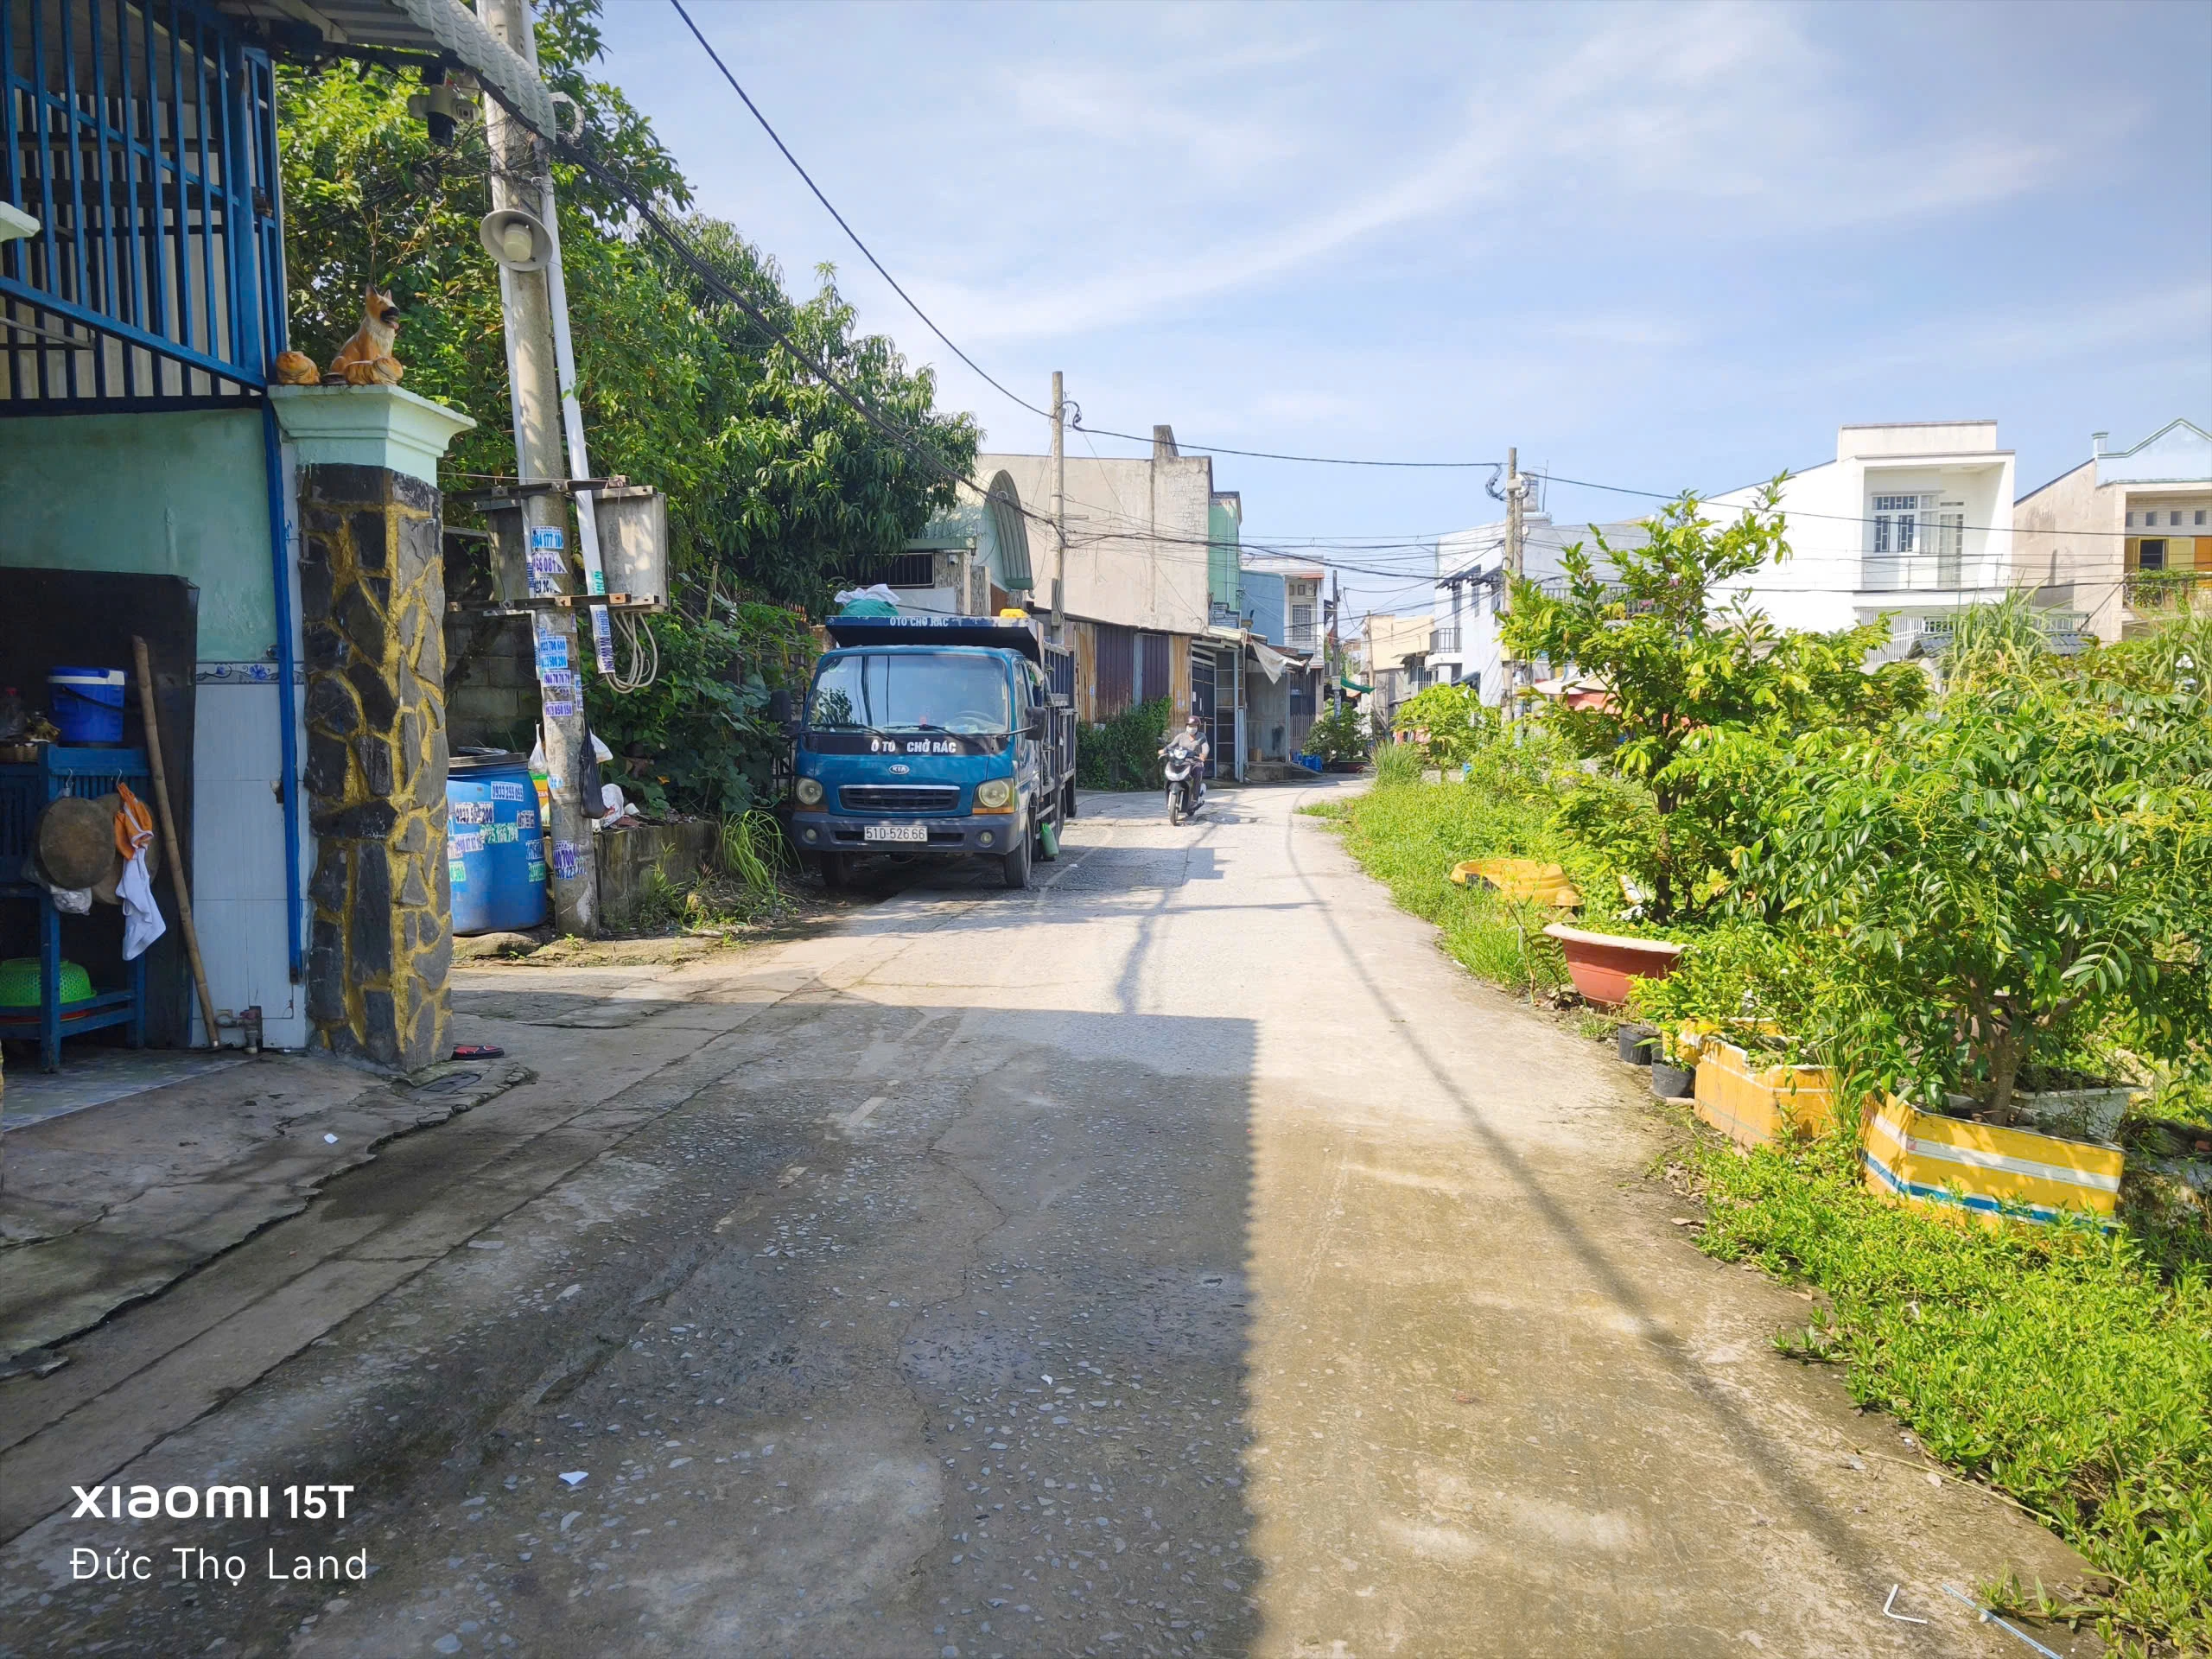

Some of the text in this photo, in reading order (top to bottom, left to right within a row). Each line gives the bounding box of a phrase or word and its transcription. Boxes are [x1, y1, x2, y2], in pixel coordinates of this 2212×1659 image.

[871, 739, 957, 753] Ô TÔ CHỞ RÁC
[866, 827, 925, 840] 51D-526.66
